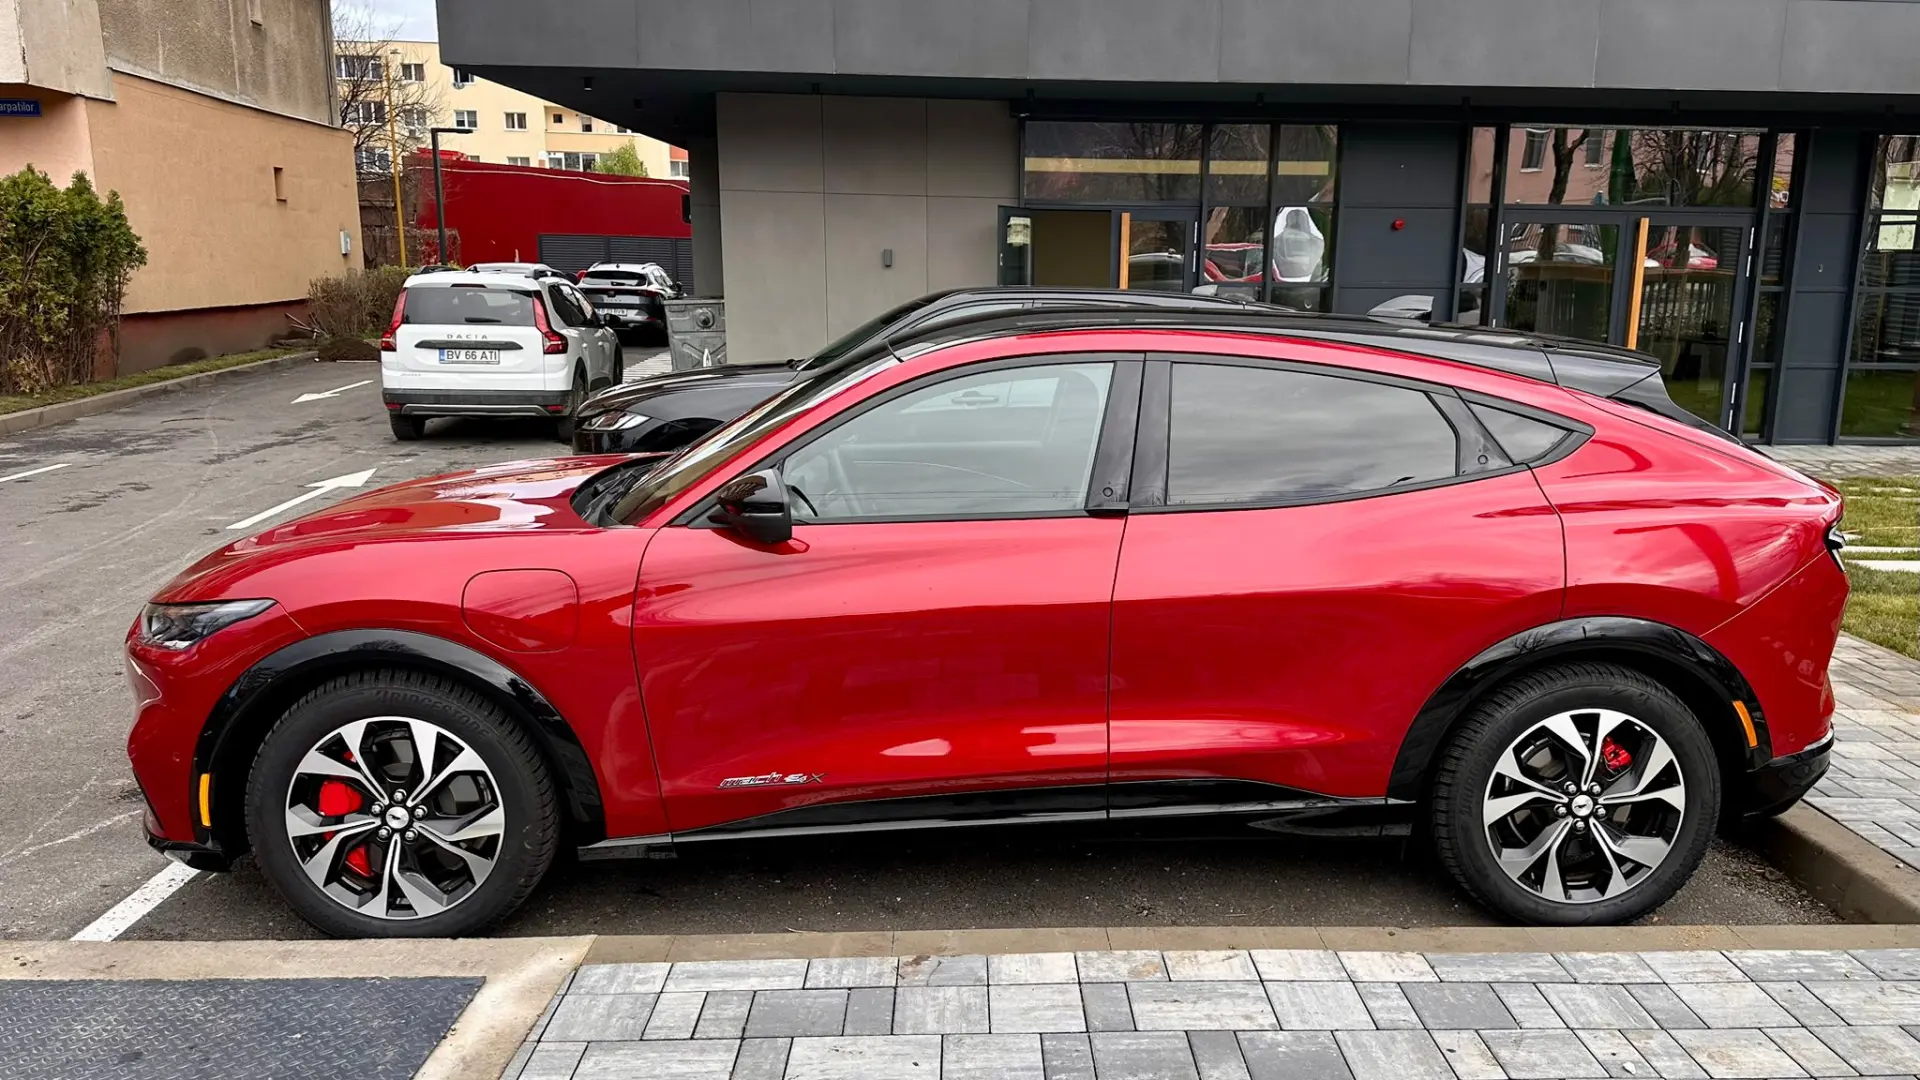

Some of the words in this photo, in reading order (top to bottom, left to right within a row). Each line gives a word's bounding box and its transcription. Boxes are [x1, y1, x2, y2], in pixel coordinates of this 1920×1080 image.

[446, 350, 461, 360] BV
[464, 350, 477, 360] 66
[480, 351, 497, 361] ATI
